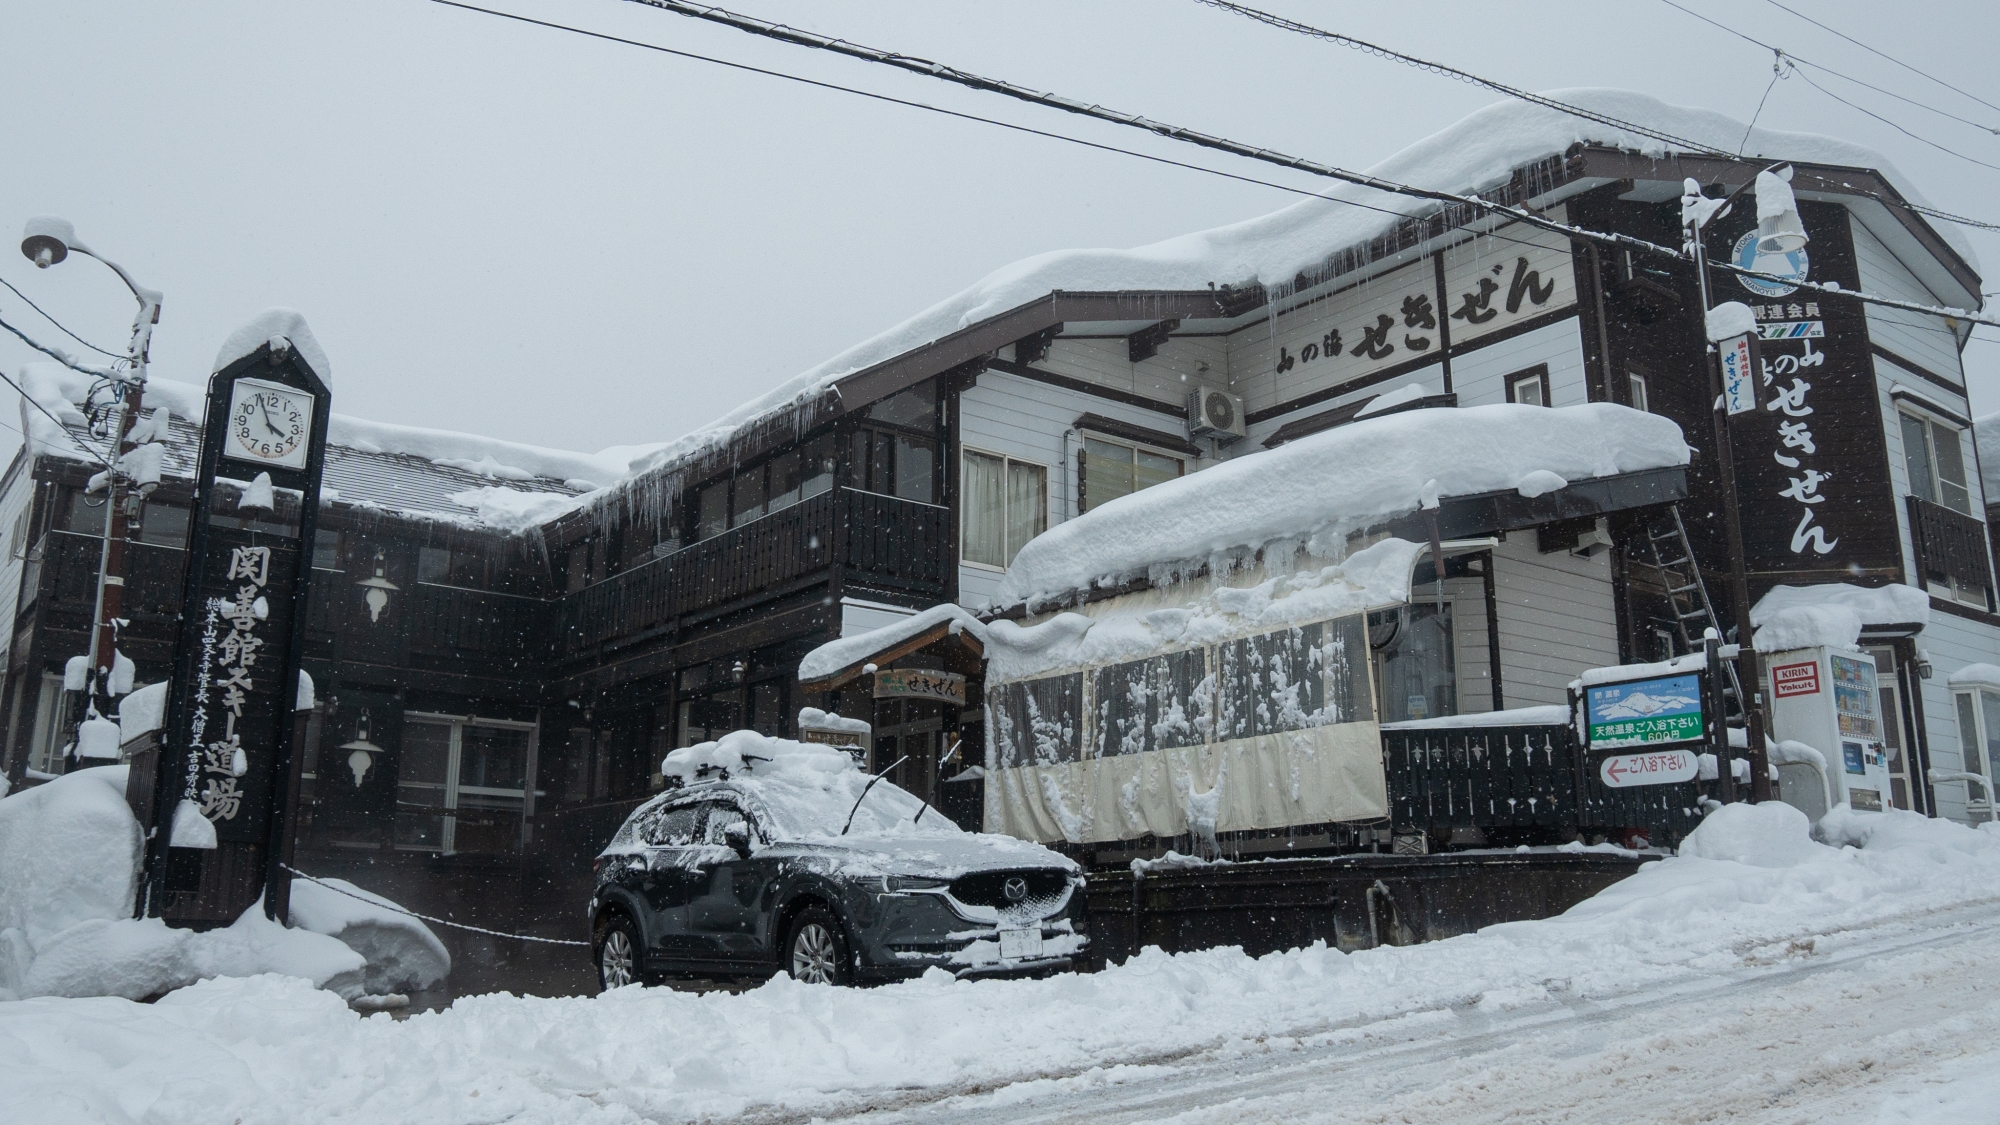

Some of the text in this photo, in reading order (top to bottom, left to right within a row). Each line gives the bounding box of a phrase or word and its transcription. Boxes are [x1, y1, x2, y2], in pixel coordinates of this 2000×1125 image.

[1734, 233, 1754, 254] MYOKO
[1276, 257, 1554, 374] 山の湯 せきぜん
[1724, 351, 1742, 411] せきぜん
[267, 396, 279, 408] 12
[283, 402, 287, 412] 1
[243, 403, 255, 415] 10
[238, 415, 247, 426] 9
[288, 411, 297, 423] 2
[241, 427, 250, 438] 8
[290, 424, 299, 435] 3
[250, 438, 259, 449] 7
[285, 436, 294, 446] 4
[261, 443, 270, 454] 6
[274, 443, 284, 453] 5
[1766, 378, 1839, 555] せきぜん
[1781, 667, 1809, 679] KIRIN
[906, 676, 957, 696] せきぜん
[1779, 681, 1814, 691] Yakult
[1595, 717, 1699, 737] 天然温泉ご入浴下さい
[1629, 754, 1687, 774] ご入浴下さい
